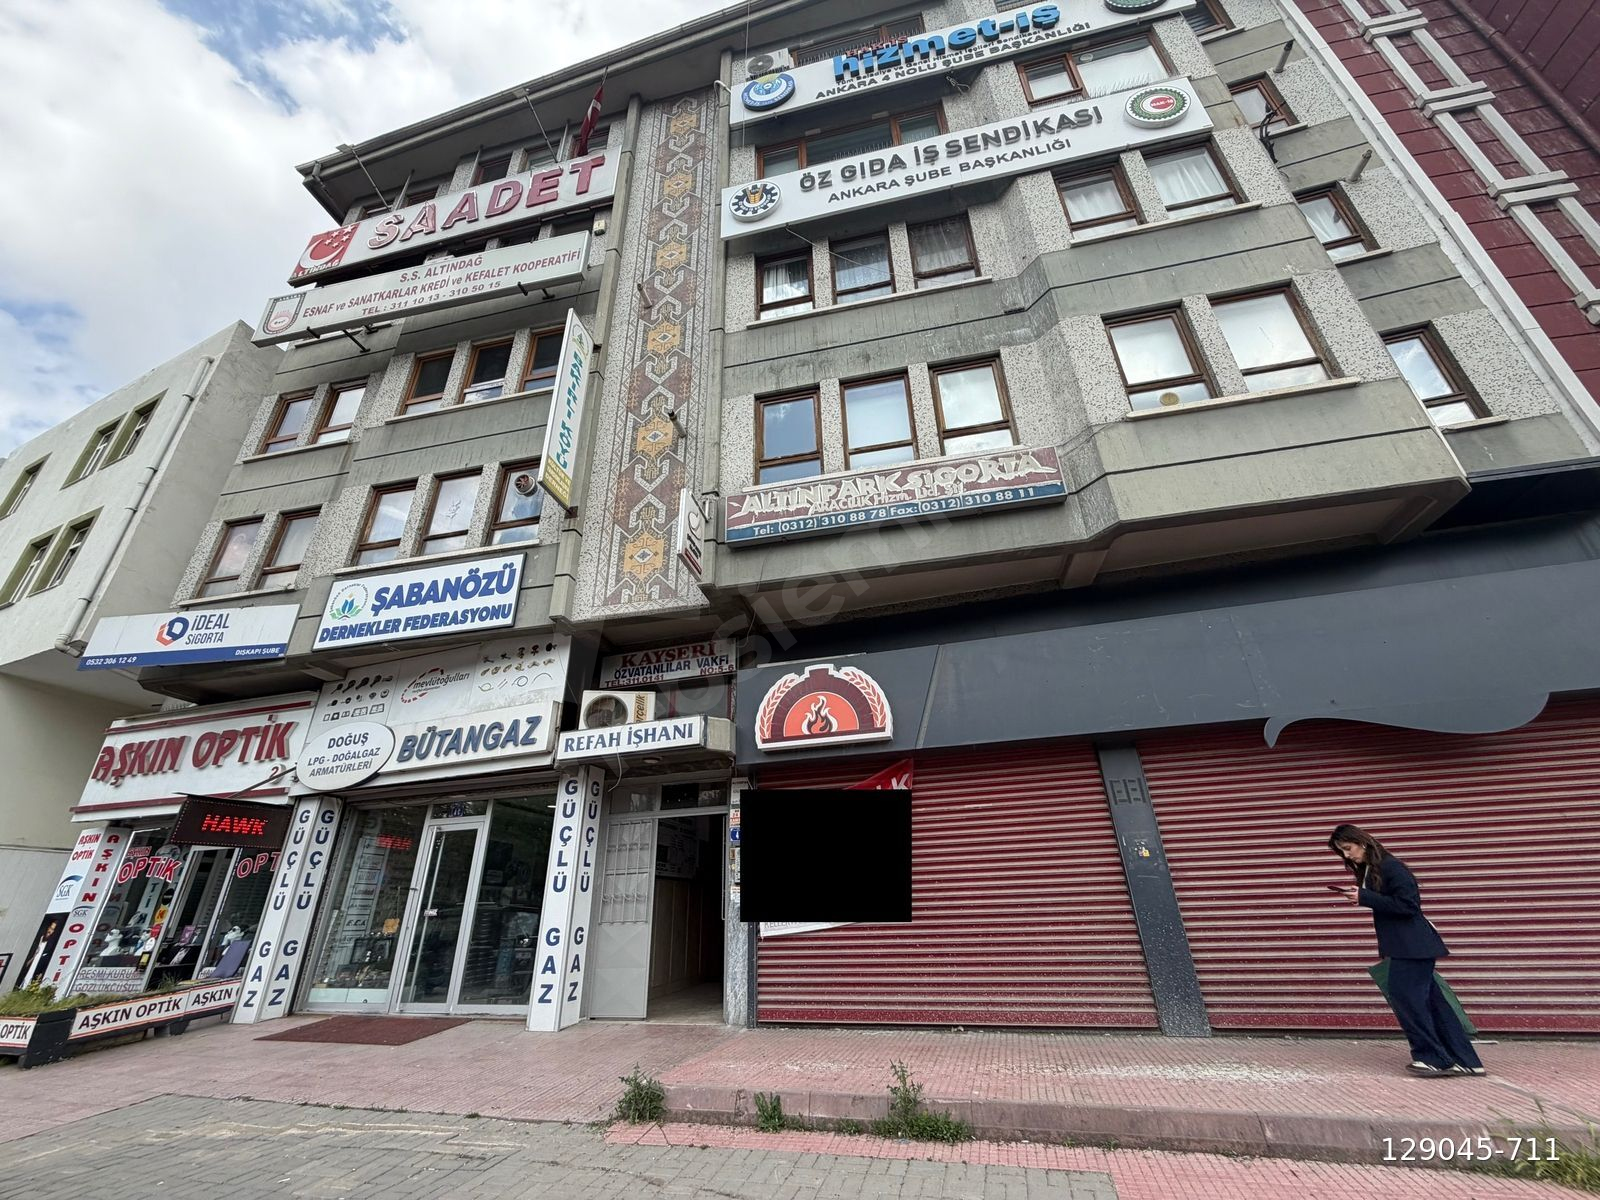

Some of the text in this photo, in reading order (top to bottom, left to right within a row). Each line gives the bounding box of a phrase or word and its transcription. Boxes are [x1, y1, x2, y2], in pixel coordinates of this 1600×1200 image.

[816, 76, 878, 100] ANKARA
[882, 74, 891, 82] 4
[895, 62, 937, 79] NOLU
[942, 50, 985, 68] ŞUBE
[989, 22, 1091, 55] BAŞKANLIĞI
[799, 105, 1103, 193] ÖZ GIDA İŞ SENDİKASI
[827, 137, 1072, 204] ANKARA ŞUBE BAŞKANLIĞI
[366, 155, 606, 250] SAADET
[302, 247, 582, 319] ESNAF ve SANATKARLAR KREDİ ve KEFALET KOOPERATİFİ
[399, 253, 483, 283] S.S. ALTINDAĞ
[362, 306, 380, 316] TEL
[389, 300, 408, 310] 311
[413, 297, 425, 306] 10
[428, 292, 440, 304] 13
[449, 286, 469, 298] 310
[471, 283, 485, 292] 50
[488, 280, 501, 289] 15
[728, 470, 902, 522] ALTINPARK
[753, 524, 774, 536] Tel:
[778, 518, 817, 534] (0312)
[821, 514, 846, 526] 310
[849, 511, 866, 522] 88
[869, 509, 887, 520] 78
[965, 493, 991, 506] 310
[995, 489, 1014, 500] 88
[1018, 487, 1035, 498] 11
[808, 493, 873, 517] ARACILIK
[873, 489, 912, 505] Hizm.
[371, 562, 517, 617] ŞABANÖZÜ
[318, 603, 513, 643] DERNEKLER FEDERASYONU
[85, 657, 103, 666] 0532
[103, 657, 117, 665] 306
[126, 656, 137, 664] 49
[262, 647, 280, 656] ŞUBE
[621, 641, 717, 668] KAYSERİ
[700, 663, 735, 676] NO:5-6
[413, 672, 470, 690] mevlütoğulları
[91, 713, 299, 787] AŞKIN OPTİK
[327, 731, 369, 750] DOĞUŞ
[396, 715, 543, 763] BÜTANGAZ
[565, 722, 693, 753] REFAH İŞHANI
[307, 756, 325, 767] LPG
[332, 747, 380, 763] DOĞALGAZ
[309, 758, 373, 778] ARMATÜRLERİ
[201, 814, 268, 835] HAWK
[72, 847, 95, 861] OPTİK
[78, 833, 101, 848] AŞKIN
[237, 852, 282, 878] OPT
[56, 884, 73, 898] SGK
[73, 909, 89, 917] SGK
[243, 941, 272, 1008] GAZ
[267, 939, 298, 1006] GAZ
[537, 926, 560, 1004] GAZ
[567, 926, 585, 1002] GAZ
[191, 986, 233, 1008] AŞKIN
[78, 995, 182, 1031] AŞKIN OPTİK
[0, 1022, 31, 1040] OPTİK
